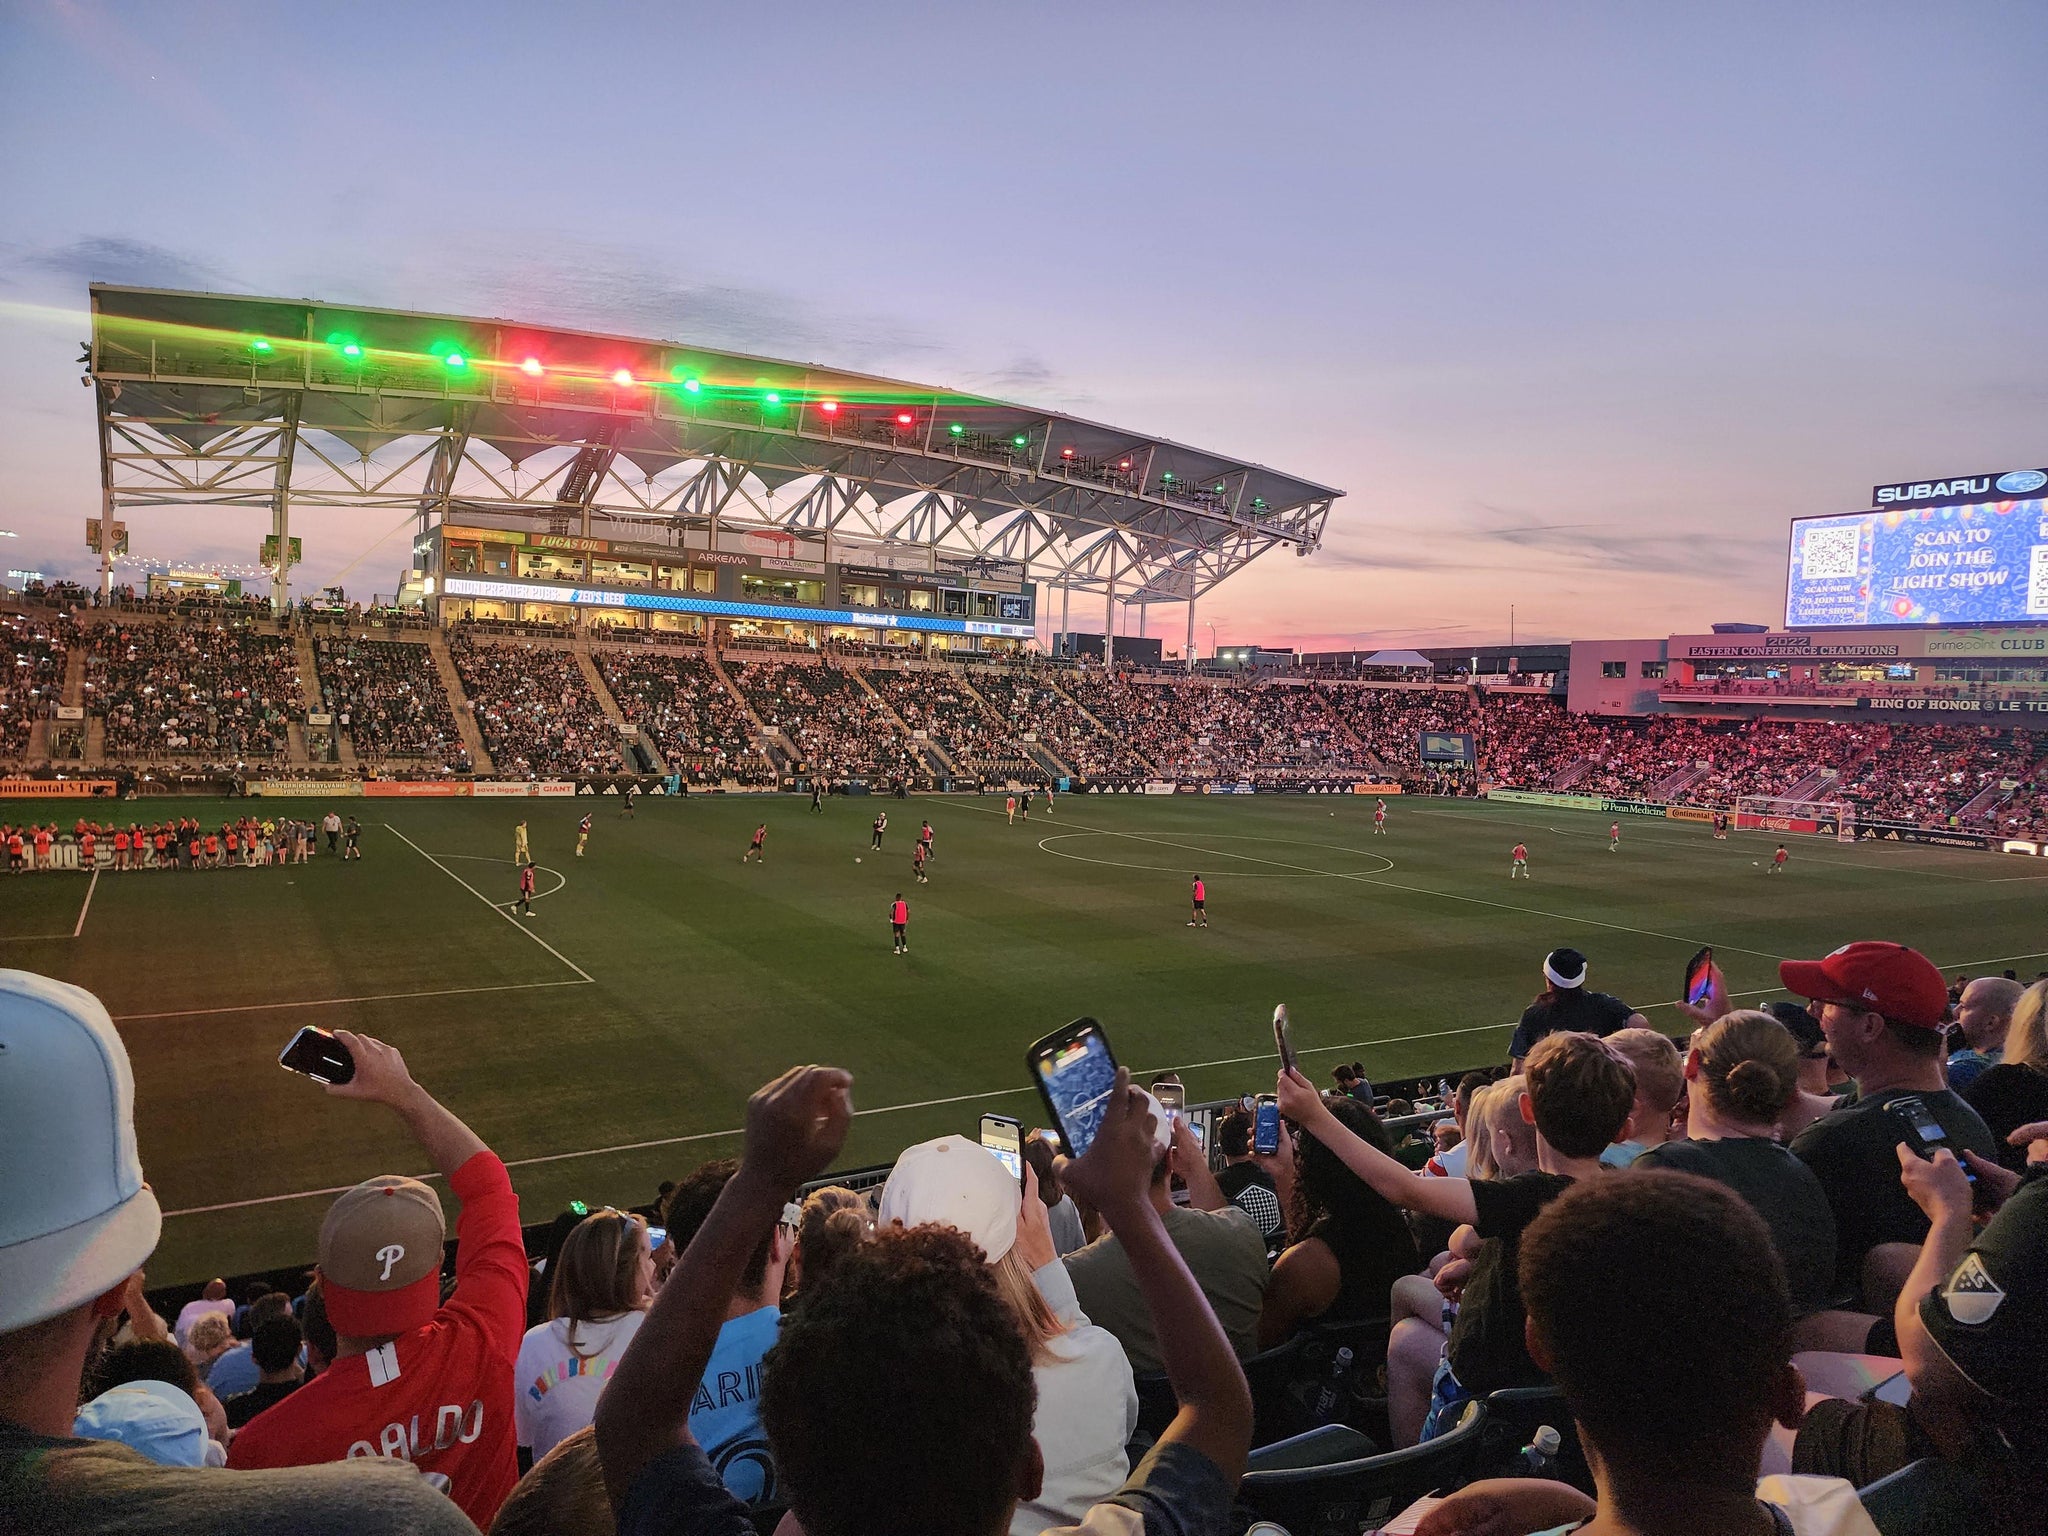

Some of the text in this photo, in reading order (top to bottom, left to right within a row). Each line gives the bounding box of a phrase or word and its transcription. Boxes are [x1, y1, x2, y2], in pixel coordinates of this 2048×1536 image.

[1877, 478, 1990, 502] SUBARU
[608, 515, 689, 541] Whirlpool
[540, 535, 578, 549] LUCAS
[580, 539, 599, 551] OIL
[1914, 528, 1991, 547] SCAN TO
[698, 552, 748, 565] ARKEMA
[769, 559, 793, 568] ROYAL
[1907, 550, 1995, 570] JOIN THE
[1893, 571, 2009, 590] LIGHT SHOW
[449, 581, 481, 595] UNION
[484, 584, 529, 598] PREMIER
[1805, 585, 1851, 594] SCAN NOW
[1768, 638, 1808, 646] 2022
[1929, 640, 2045, 653] primepoint CLUB
[1691, 646, 1897, 656] EASTERN CONFERENCE CHAMPIONS
[1870, 699, 1903, 708] RING
[1907, 699, 1925, 710] OF
[1928, 700, 1980, 711] HONOR
[1999, 702, 2021, 711] LE
[1610, 803, 1667, 816] Penn Medicine
[1672, 809, 1710, 819] Continental
[1930, 837, 1976, 847] POWERWASH
[376, 1244, 404, 1281] P
